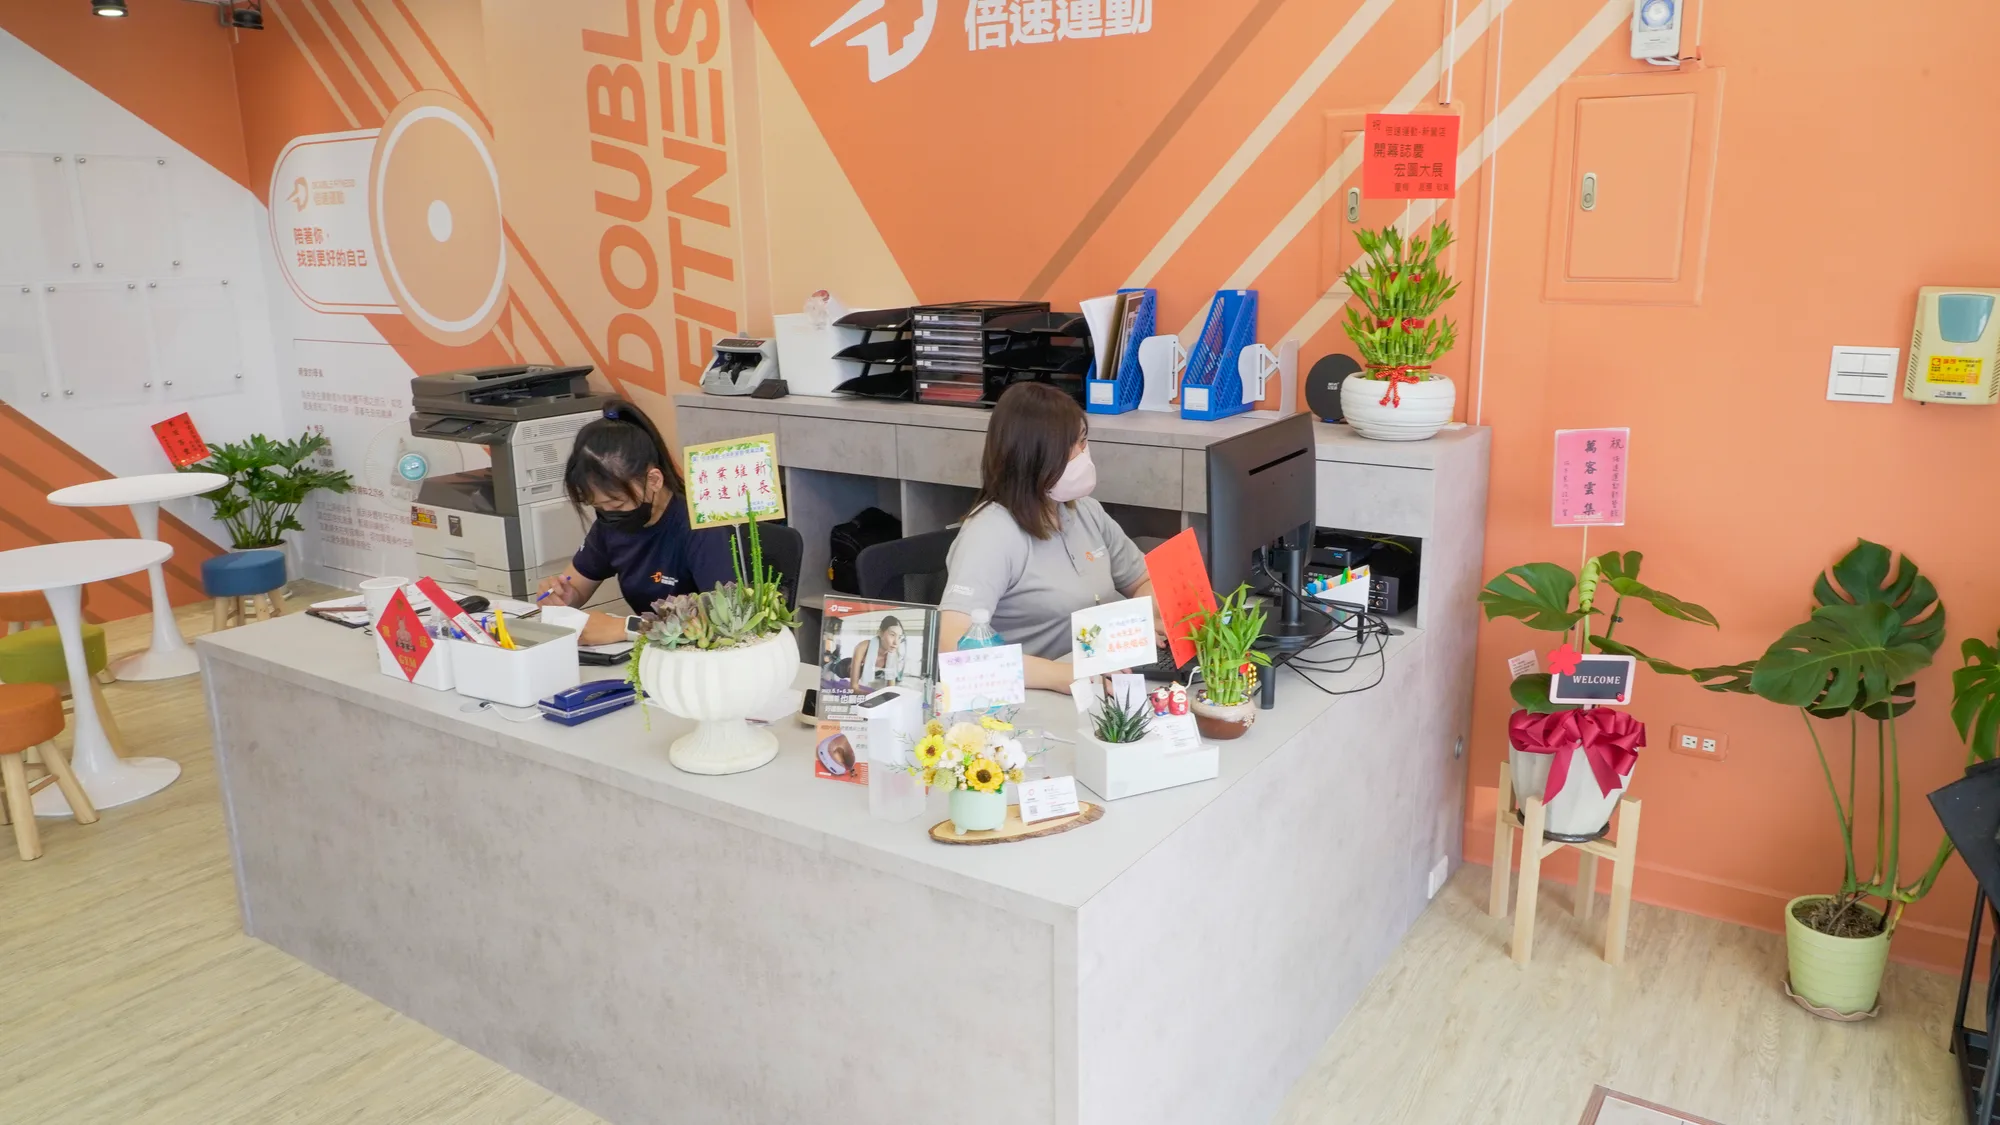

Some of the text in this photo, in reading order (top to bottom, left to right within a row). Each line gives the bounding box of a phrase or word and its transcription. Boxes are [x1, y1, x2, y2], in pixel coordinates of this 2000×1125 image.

[964, 0, 1153, 51] 倍速運動
[1372, 119, 1381, 131] 祝
[1373, 142, 1424, 158] 開幕誌慶
[1394, 162, 1443, 177] 宏圖大展
[297, 249, 368, 267] 找到更好的自己
[1610, 438, 1624, 449] 祝
[1583, 439, 1597, 516] 萬客雲集
[699, 479, 771, 501] 源遠流長
[1573, 675, 1621, 685] WELCOME
